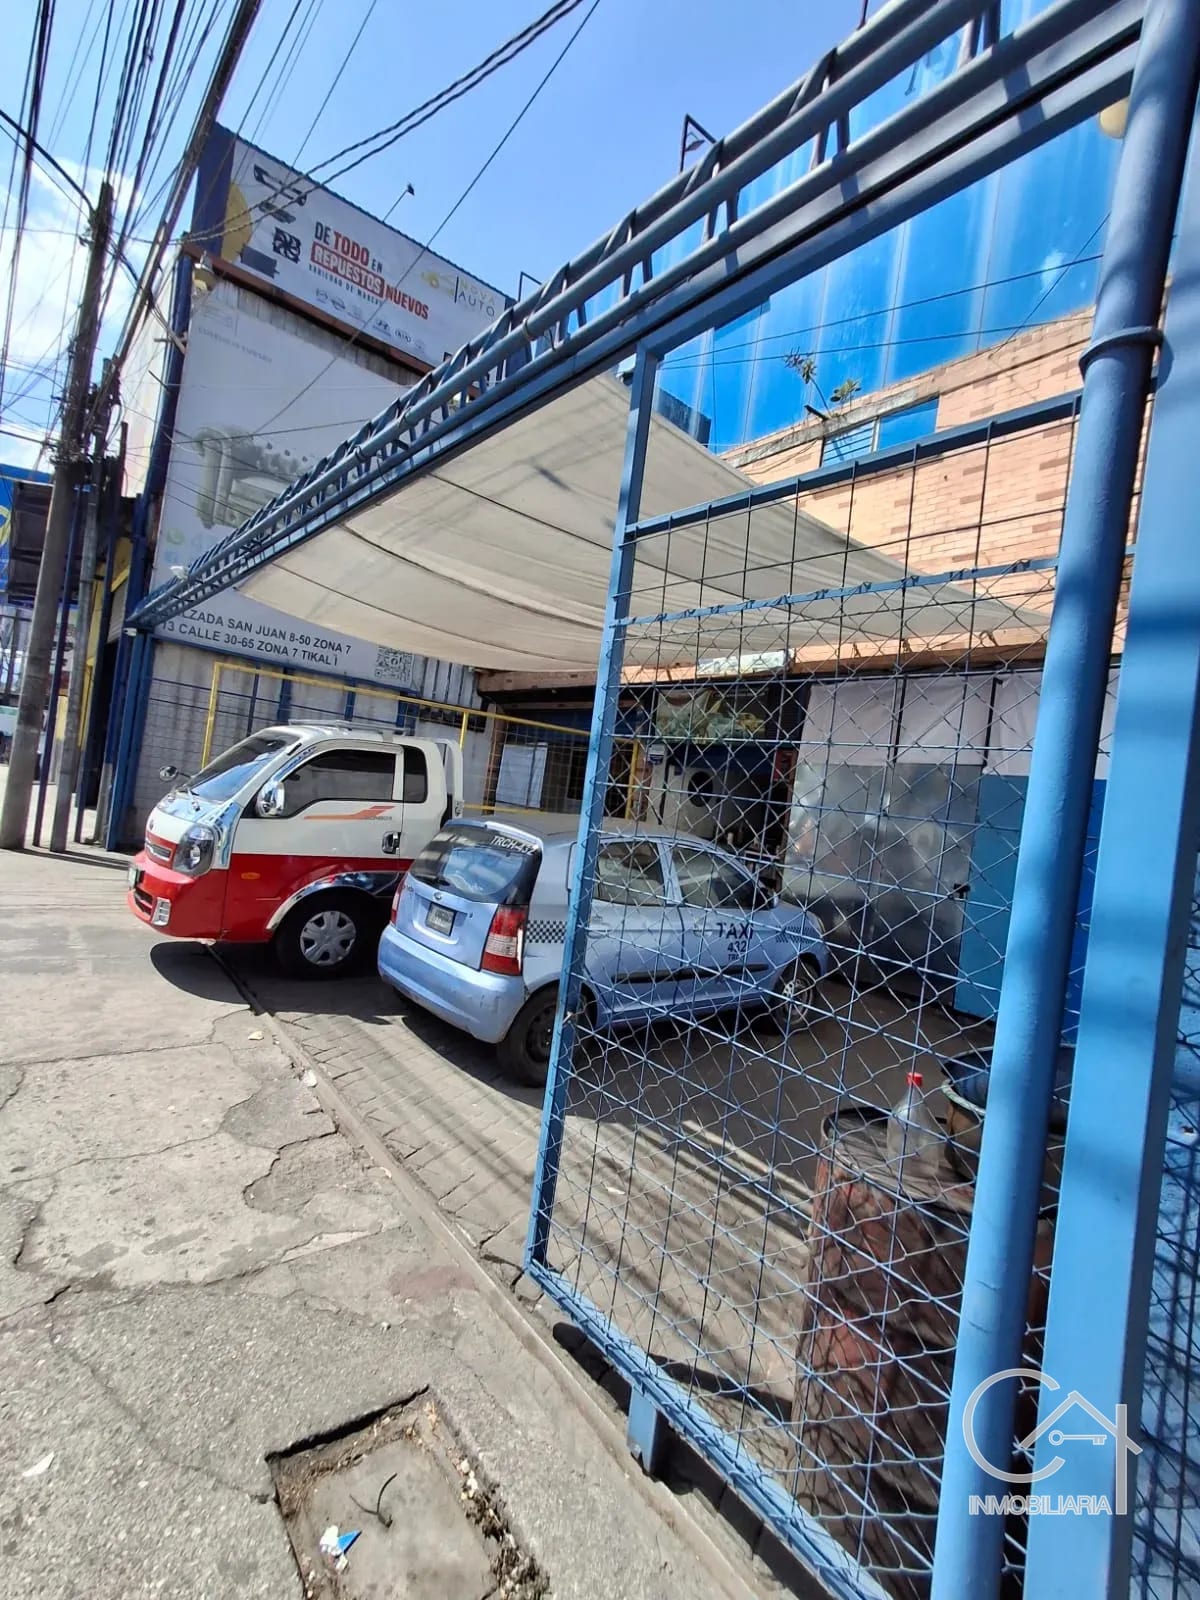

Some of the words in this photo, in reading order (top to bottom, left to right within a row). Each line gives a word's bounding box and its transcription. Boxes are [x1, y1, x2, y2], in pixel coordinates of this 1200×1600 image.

[314, 221, 332, 246] DE
[333, 231, 370, 267] TODO
[371, 258, 383, 273] EN
[313, 244, 383, 295] REPUESTOS
[385, 285, 429, 320] NUEVOS
[458, 291, 495, 317] AUTO
[179, 623, 221, 642] CALLE
[223, 633, 255, 649] 30-65
[257, 640, 289, 656] ZONA
[292, 648, 298, 657] 7
[301, 650, 331, 666] TIKAL
[227, 618, 253, 633] SAN
[255, 625, 287, 641] JUAN
[289, 632, 311, 646] 8-50
[313, 638, 342, 653] ZONA
[345, 645, 352, 656] 7
[489, 835, 536, 856] TRCH-432
[715, 922, 754, 940] TAXI
[727, 940, 748, 954] 432
